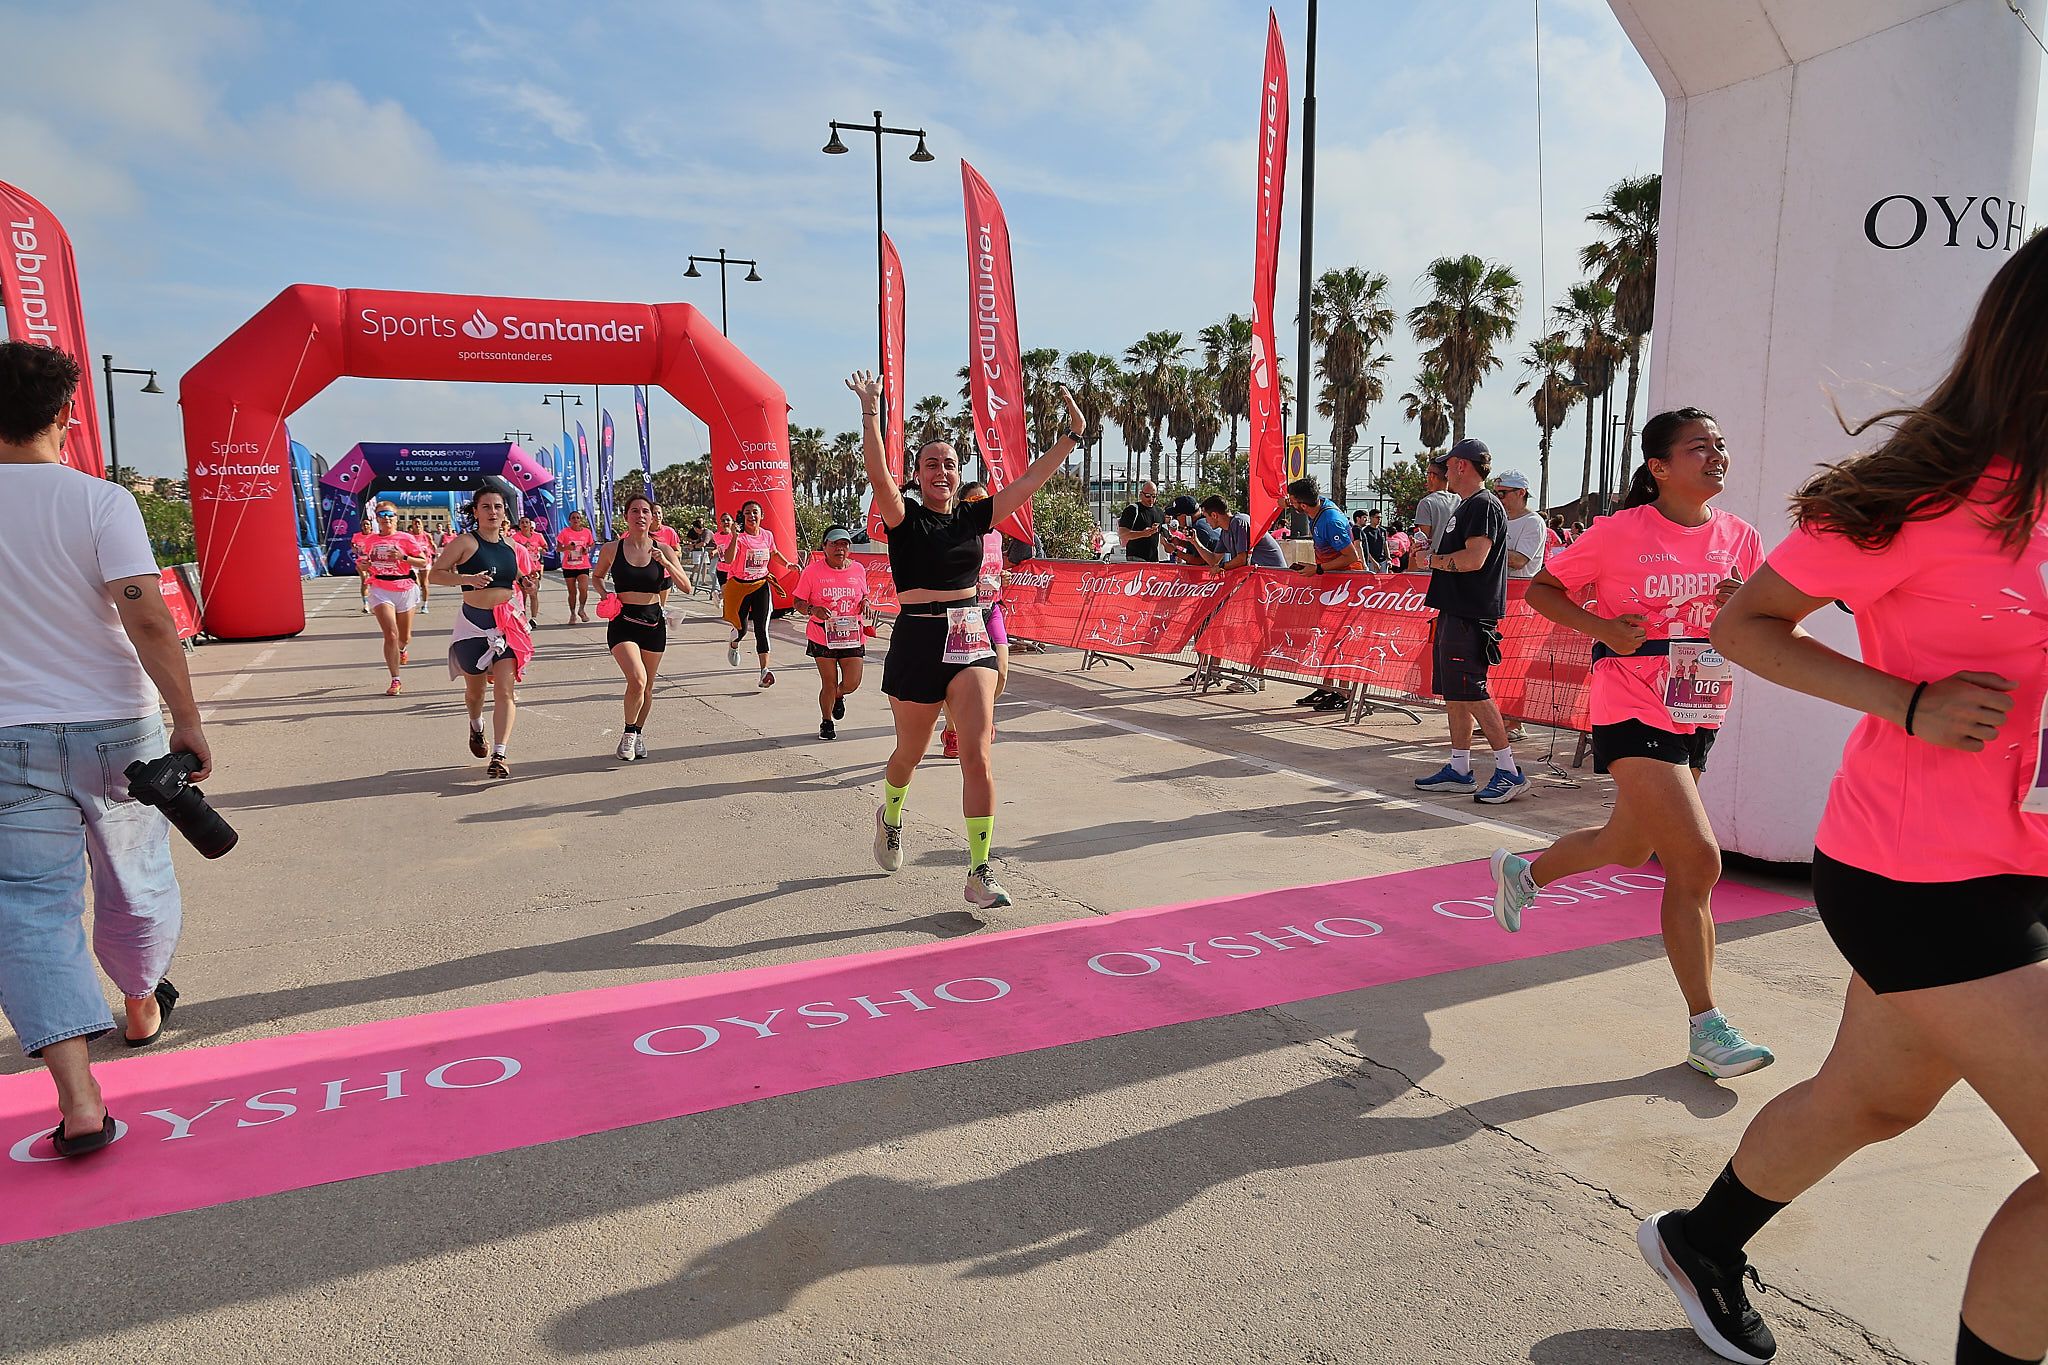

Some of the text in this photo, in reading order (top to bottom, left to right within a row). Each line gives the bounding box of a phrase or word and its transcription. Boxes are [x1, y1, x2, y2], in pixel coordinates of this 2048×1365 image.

[1864, 195, 2026, 251] OYSH
[361, 309, 644, 342] Sports Santander
[458, 349, 553, 361] sportssantander.es
[211, 441, 259, 456] Sports
[411, 449, 475, 459] octopus energy
[742, 441, 777, 454] Sports
[209, 463, 280, 476] Santander
[1009, 570, 1055, 590] antander
[1076, 571, 1225, 598] Sports Santander
[1644, 573, 1721, 598] CARRER
[1257, 581, 1321, 611] Sports
[966, 633, 980, 643] 016
[1695, 681, 1720, 694] 016
[1432, 873, 1666, 920] OSHO
[1087, 917, 1384, 977] OYSHO
[632, 977, 1011, 1056] OYSHO
